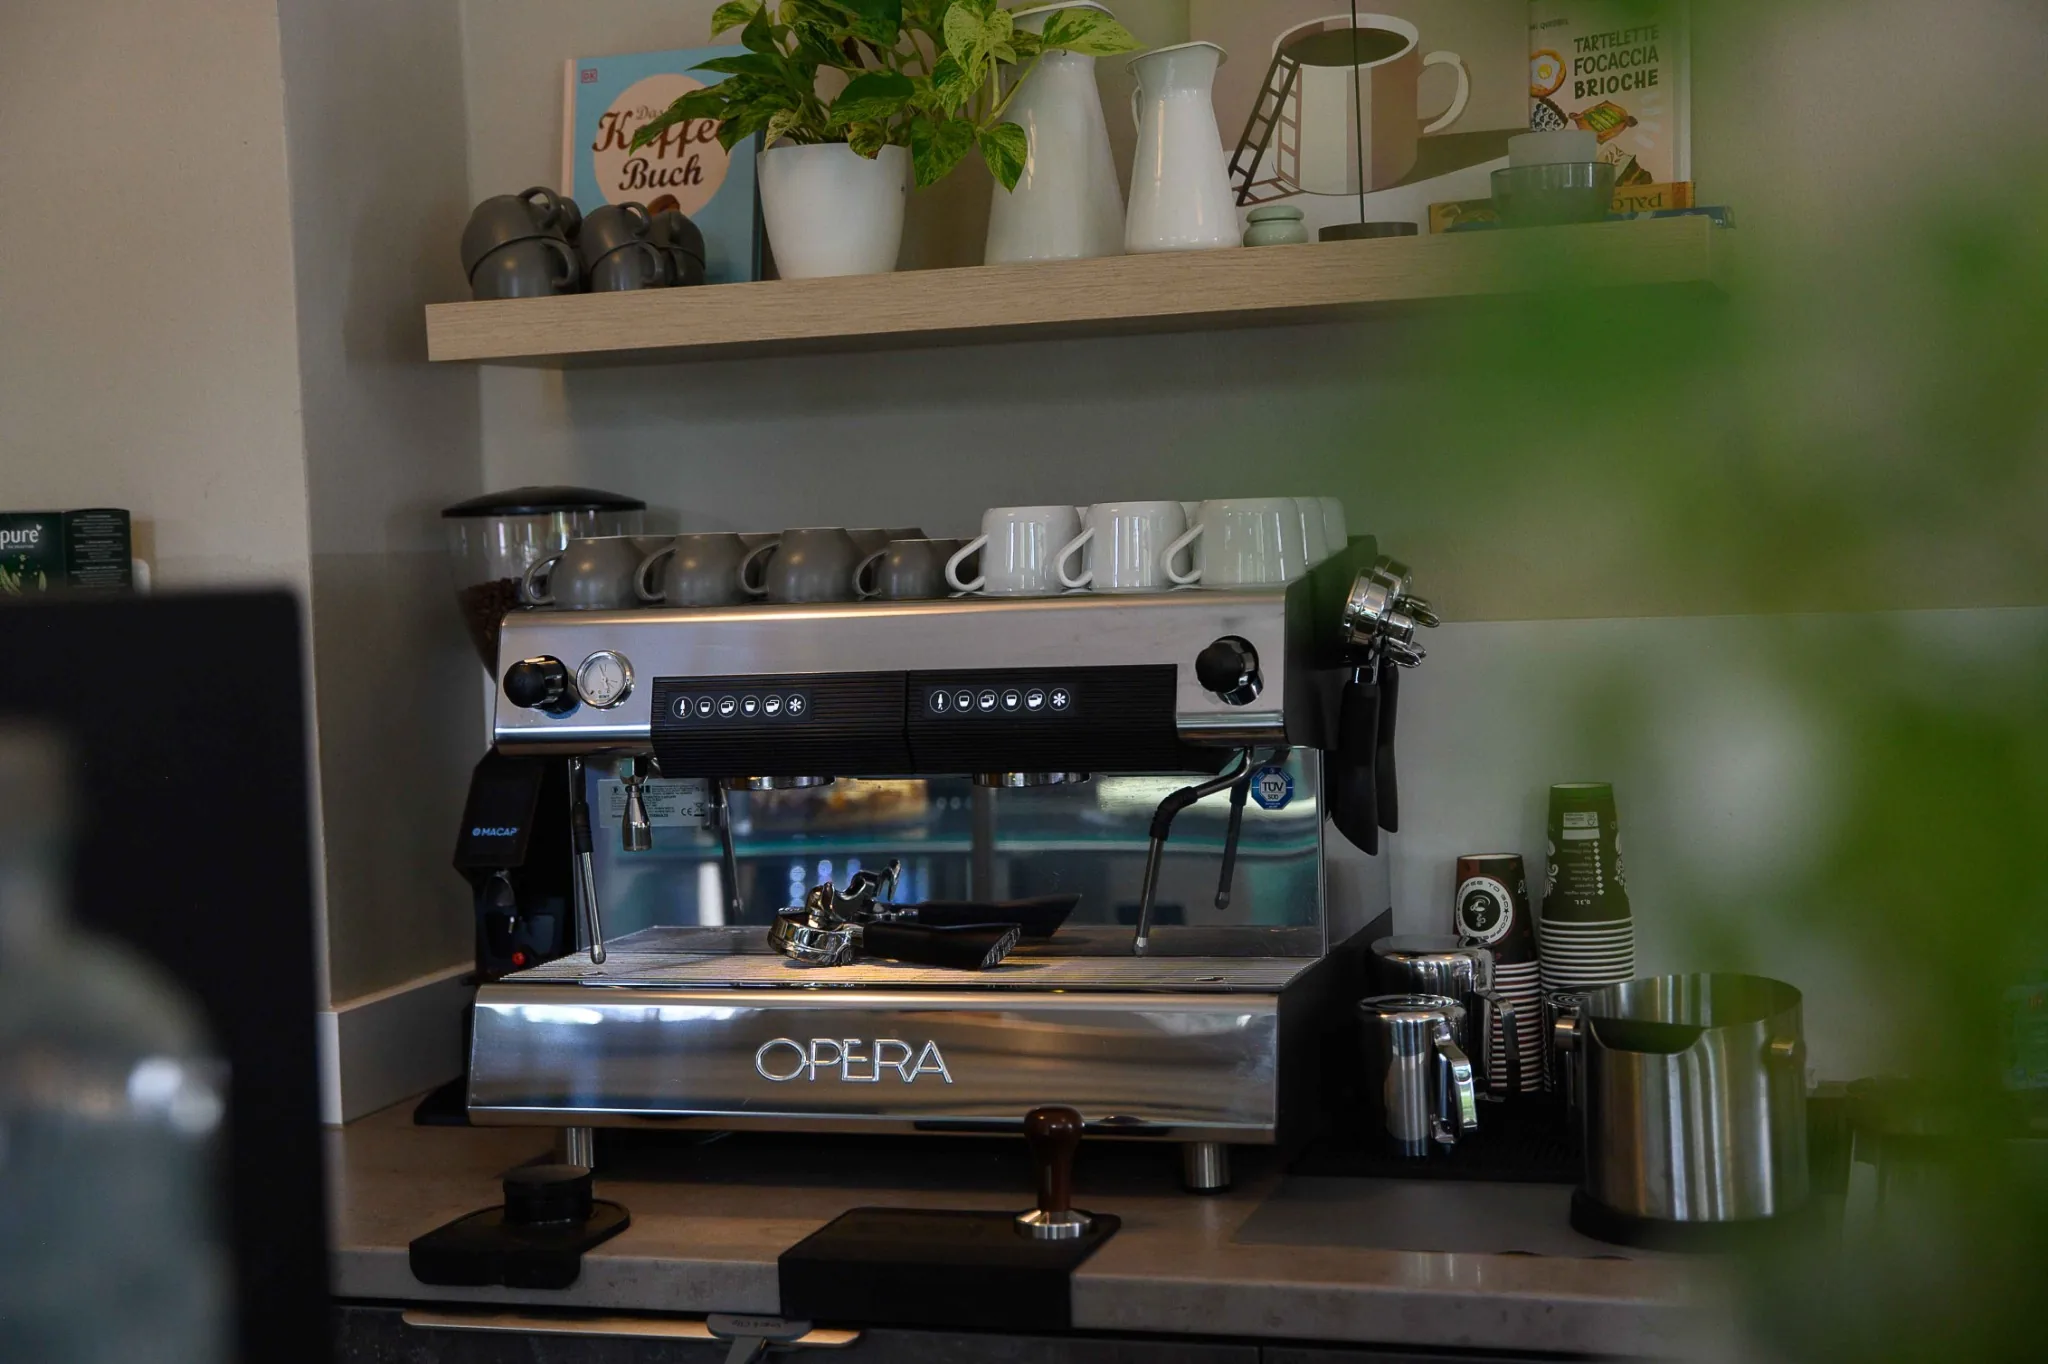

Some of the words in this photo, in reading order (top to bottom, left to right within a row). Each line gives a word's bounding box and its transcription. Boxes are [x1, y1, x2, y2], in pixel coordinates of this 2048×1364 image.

[1573, 24, 1659, 54] TARTELETTE
[1573, 45, 1659, 76] FOCACCIA
[1574, 68, 1659, 100] BRIOCHE
[618, 153, 703, 191] Buch
[0, 529, 39, 550] pure
[1262, 781, 1284, 792] TÜV
[681, 807, 693, 816] CE
[481, 827, 518, 837] MACAP
[1487, 881, 1500, 893] TO
[755, 1037, 953, 1083] OPERA
